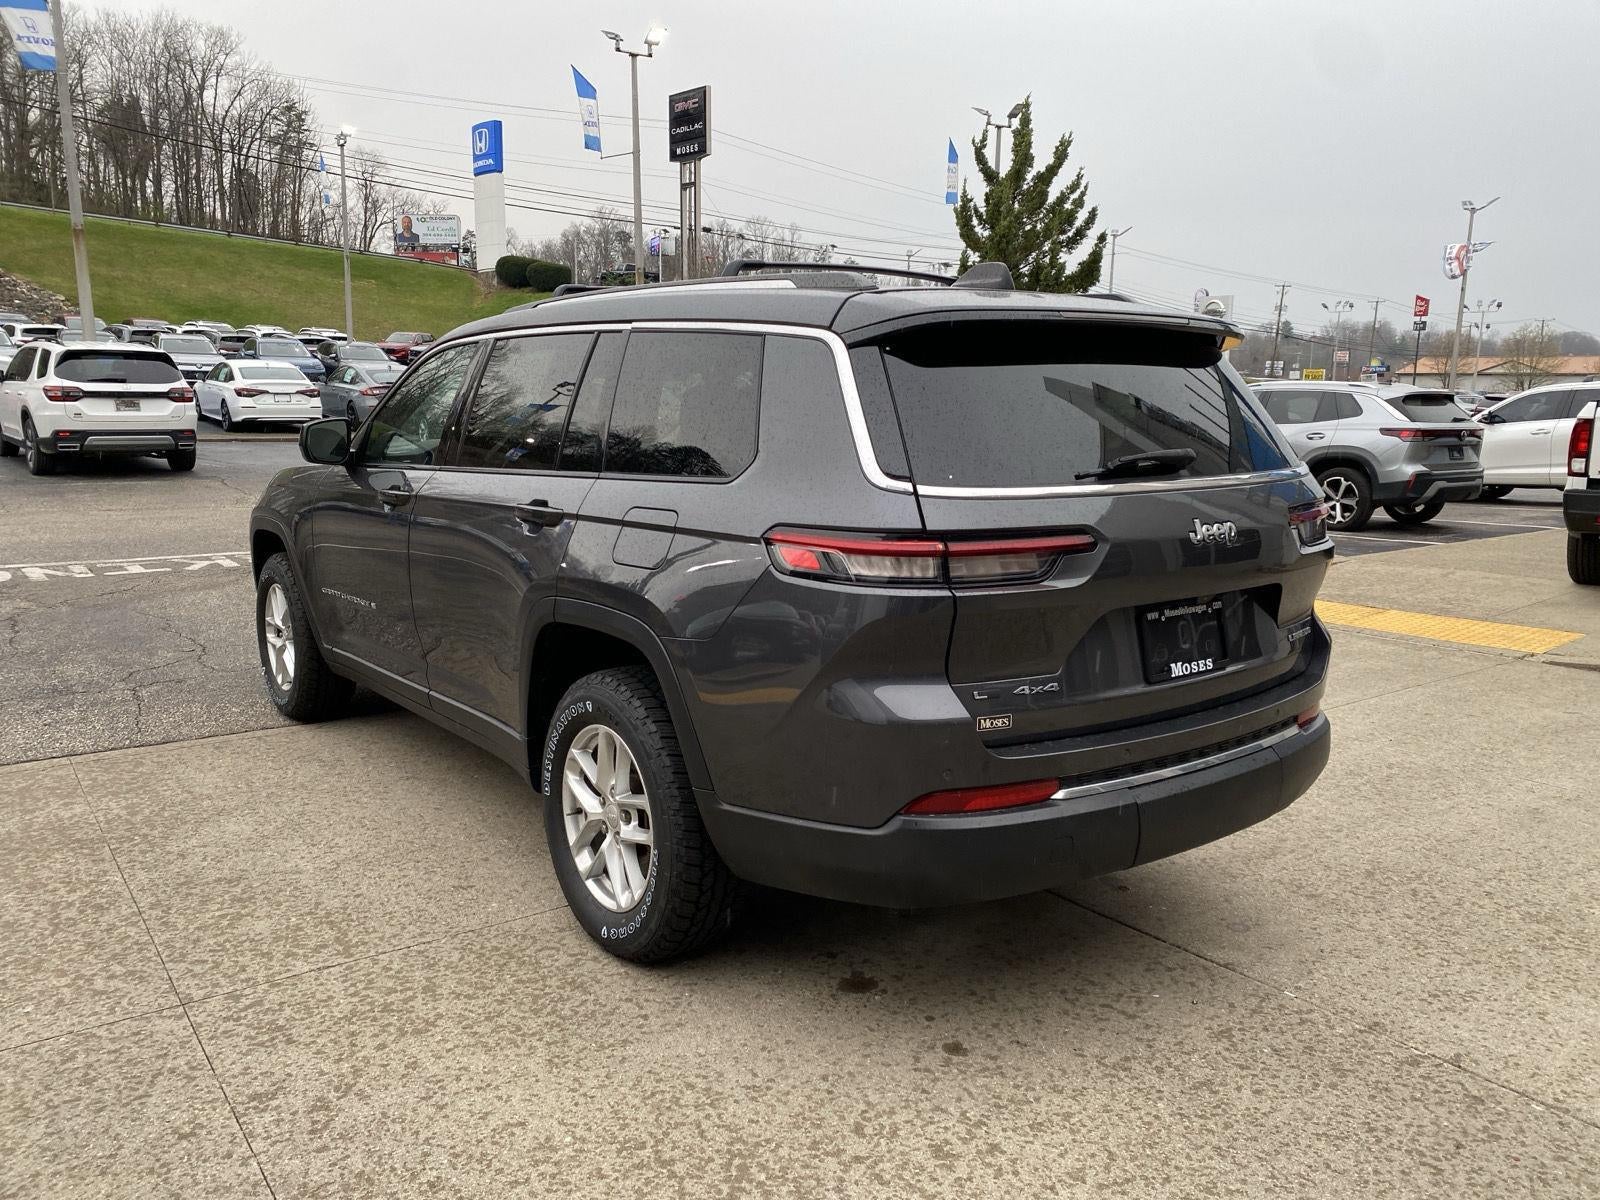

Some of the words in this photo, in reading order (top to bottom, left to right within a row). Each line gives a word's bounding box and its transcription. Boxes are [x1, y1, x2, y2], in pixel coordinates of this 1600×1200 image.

[674, 98, 699, 112] GMC
[671, 121, 703, 135] CADILLAC
[676, 143, 699, 155] MOSES
[1189, 518, 1237, 547] Jeep
[1170, 658, 1213, 677] MOSES
[973, 691, 988, 699] L
[980, 718, 1009, 729] MOSES
[543, 701, 585, 796] DESTINATION
